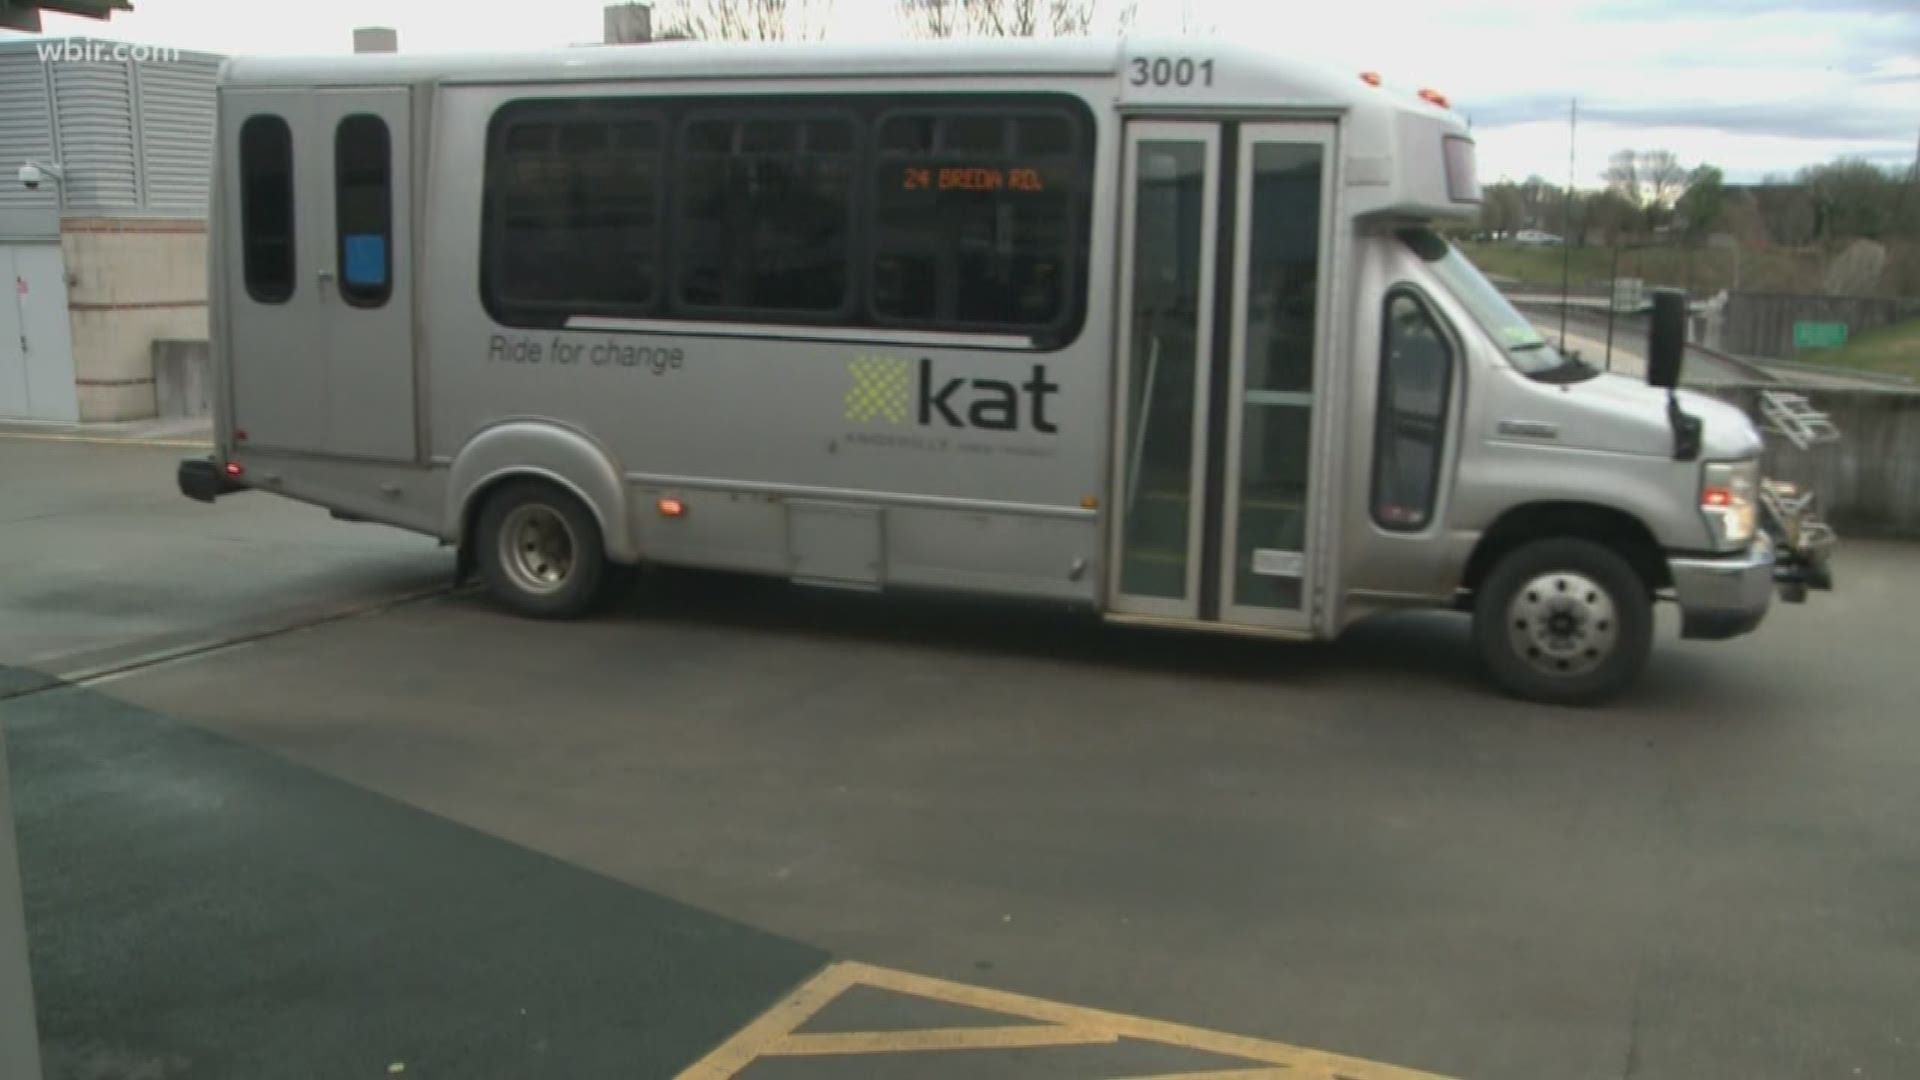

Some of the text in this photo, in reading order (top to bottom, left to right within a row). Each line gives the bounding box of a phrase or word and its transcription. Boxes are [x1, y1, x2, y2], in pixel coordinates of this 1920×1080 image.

[1130, 57, 1214, 87] 3001
[904, 169, 930, 190] 24
[488, 335, 685, 376] Ride for change
[918, 357, 1058, 434] kat
